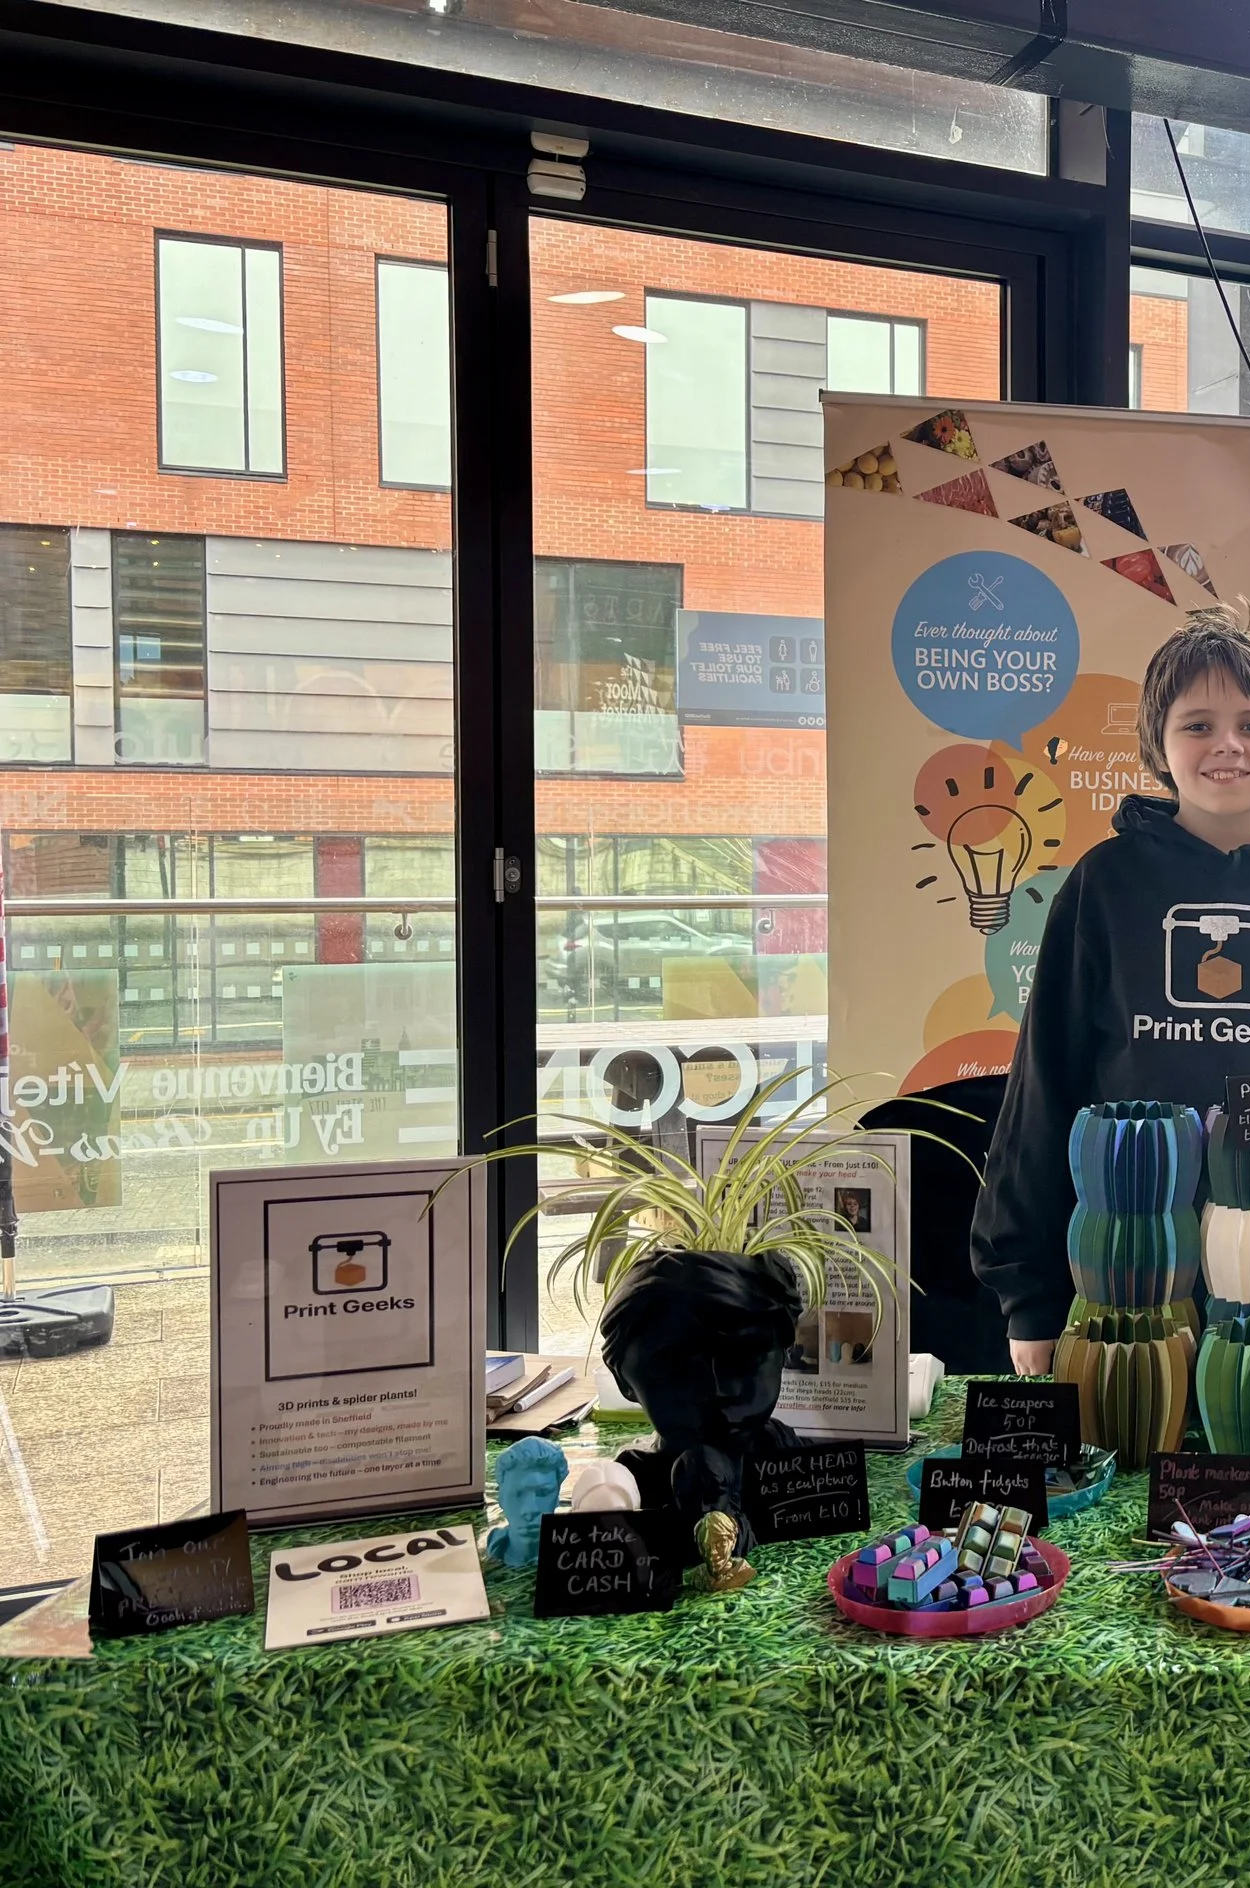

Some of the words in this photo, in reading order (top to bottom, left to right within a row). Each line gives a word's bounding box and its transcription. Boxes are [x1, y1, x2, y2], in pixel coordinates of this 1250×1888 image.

[914, 621, 949, 638] Ever
[951, 622, 1011, 648] thought
[1014, 626, 1058, 643] about
[915, 648, 986, 669] BEING
[993, 650, 1057, 671] YOUR
[917, 671, 979, 692] OWN
[986, 673, 1054, 693] BOSS?
[1068, 746, 1105, 761] Have
[1106, 751, 1137, 770] you
[1070, 771, 1168, 791] BUSINES
[1010, 941, 1041, 956] Wan
[1133, 1014, 1203, 1042] Print
[796, 1170, 816, 1178] make
[817, 1171, 837, 1179] your
[846, 1161, 861, 1170] just
[862, 1161, 879, 1169] £10!
[284, 1302, 337, 1319] Print
[342, 1296, 416, 1314] Geeks
[278, 1401, 294, 1412] 3D
[296, 1399, 330, 1411] prints
[332, 1396, 340, 1406] &
[343, 1394, 378, 1406] spider
[380, 1388, 418, 1403] plants!
[977, 1392, 998, 1408] Ice
[259, 1421, 294, 1432] Proudly
[295, 1418, 321, 1427] made
[332, 1413, 372, 1424] Sheffield
[259, 1433, 307, 1446] Innovation
[396, 1421, 421, 1431] made
[259, 1446, 313, 1459] Sustainable
[395, 1433, 431, 1444] filament
[966, 1437, 1018, 1460] Defrost
[1022, 1438, 1058, 1453] that
[259, 1473, 312, 1486] Engineering
[313, 1471, 328, 1480] the
[329, 1467, 356, 1478] future
[755, 1456, 805, 1481] YOUR
[810, 1451, 857, 1470] HEAD
[1160, 1460, 1200, 1480] Plant
[761, 1483, 779, 1495] as
[787, 1472, 858, 1494] sculpture
[930, 1470, 973, 1489] Button
[979, 1469, 1029, 1495] fidgets
[774, 1509, 811, 1528] From
[819, 1501, 849, 1518] £10
[552, 1528, 581, 1545] We
[588, 1525, 637, 1543] take
[275, 1529, 468, 1582] LOCAL
[557, 1548, 624, 1570] CARD
[636, 1556, 659, 1567] or
[339, 1569, 373, 1579] Shop
[568, 1572, 631, 1595] CASH
